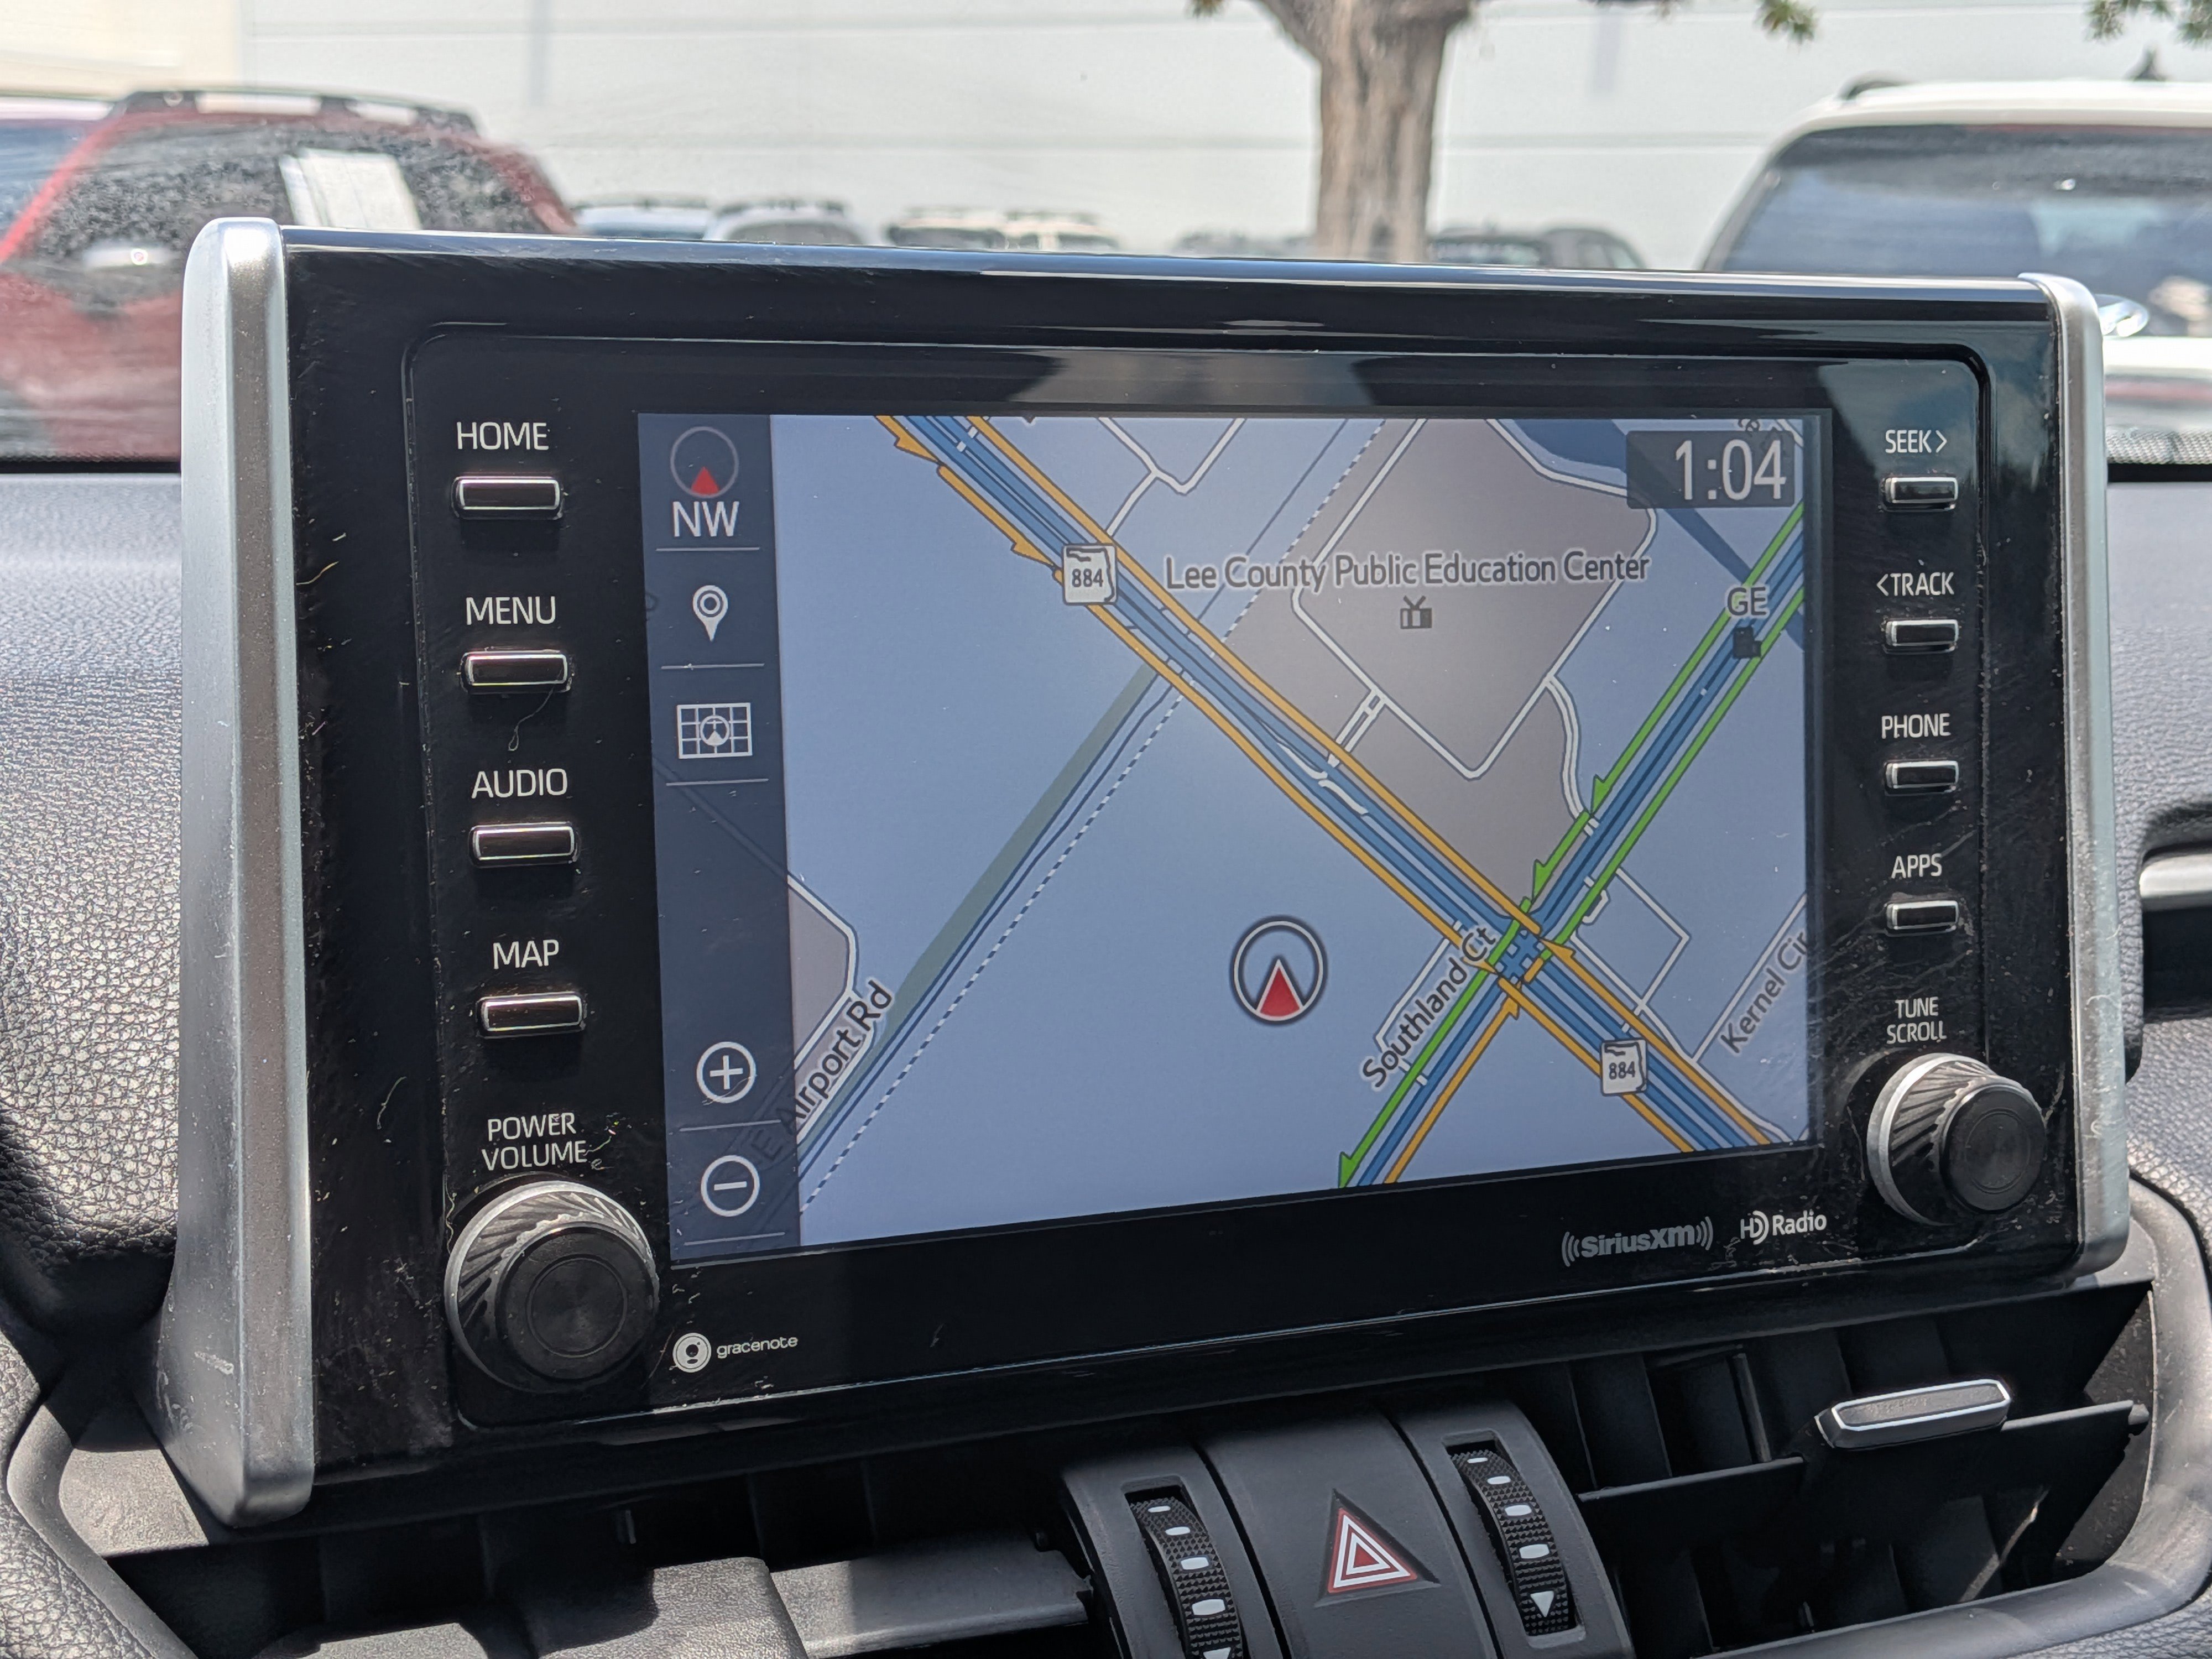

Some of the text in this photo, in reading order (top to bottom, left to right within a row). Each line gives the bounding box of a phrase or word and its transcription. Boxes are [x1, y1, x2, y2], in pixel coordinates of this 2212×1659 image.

[456, 421, 549, 450] HOME
[1676, 439, 1786, 500] 1:04
[672, 500, 740, 537] NW
[1071, 568, 1104, 587] 884
[1166, 550, 1650, 593] Lee County Public Education Center
[466, 596, 556, 625] MENU
[1727, 586, 1767, 616] GE
[1881, 713, 1952, 739] PHONE
[471, 768, 568, 799] AUDIO
[1891, 853, 1943, 879] APPS
[493, 939, 559, 969] MAP
[846, 979, 893, 1032] Rd
[1362, 927, 1496, 1088] Southland Ct
[1720, 968, 1786, 1054] Kernel
[1895, 996, 1939, 1019] TUNE
[1886, 1020, 1948, 1045] SCROLL
[1609, 1061, 1636, 1080] 884
[487, 1112, 577, 1141] POWER
[482, 1140, 588, 1171] VOLUME
[1772, 1209, 1827, 1237] Radio
[717, 1337, 799, 1359] gracenote
